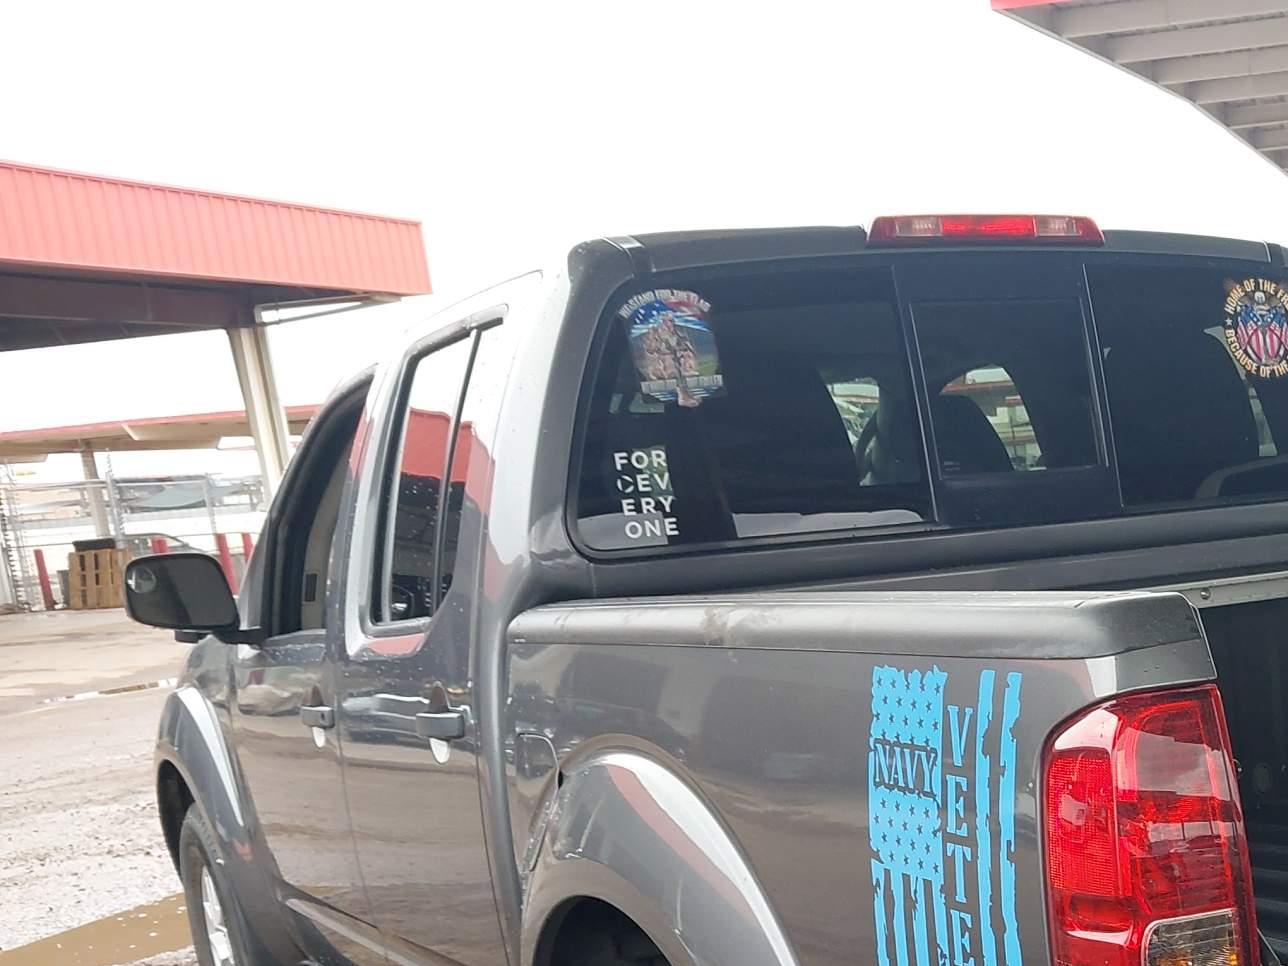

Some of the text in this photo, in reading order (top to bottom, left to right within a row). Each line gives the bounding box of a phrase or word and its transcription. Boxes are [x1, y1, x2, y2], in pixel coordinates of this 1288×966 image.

[1224, 284, 1245, 315] HOME
[1243, 279, 1255, 291] OF
[1258, 279, 1277, 295] THE
[1225, 329, 1258, 375] BECAUSE
[1260, 365, 1272, 379] OF
[613, 450, 668, 471] FOR
[621, 495, 674, 516] ERY
[624, 517, 680, 539] ONE
[873, 743, 937, 795] NAVY
